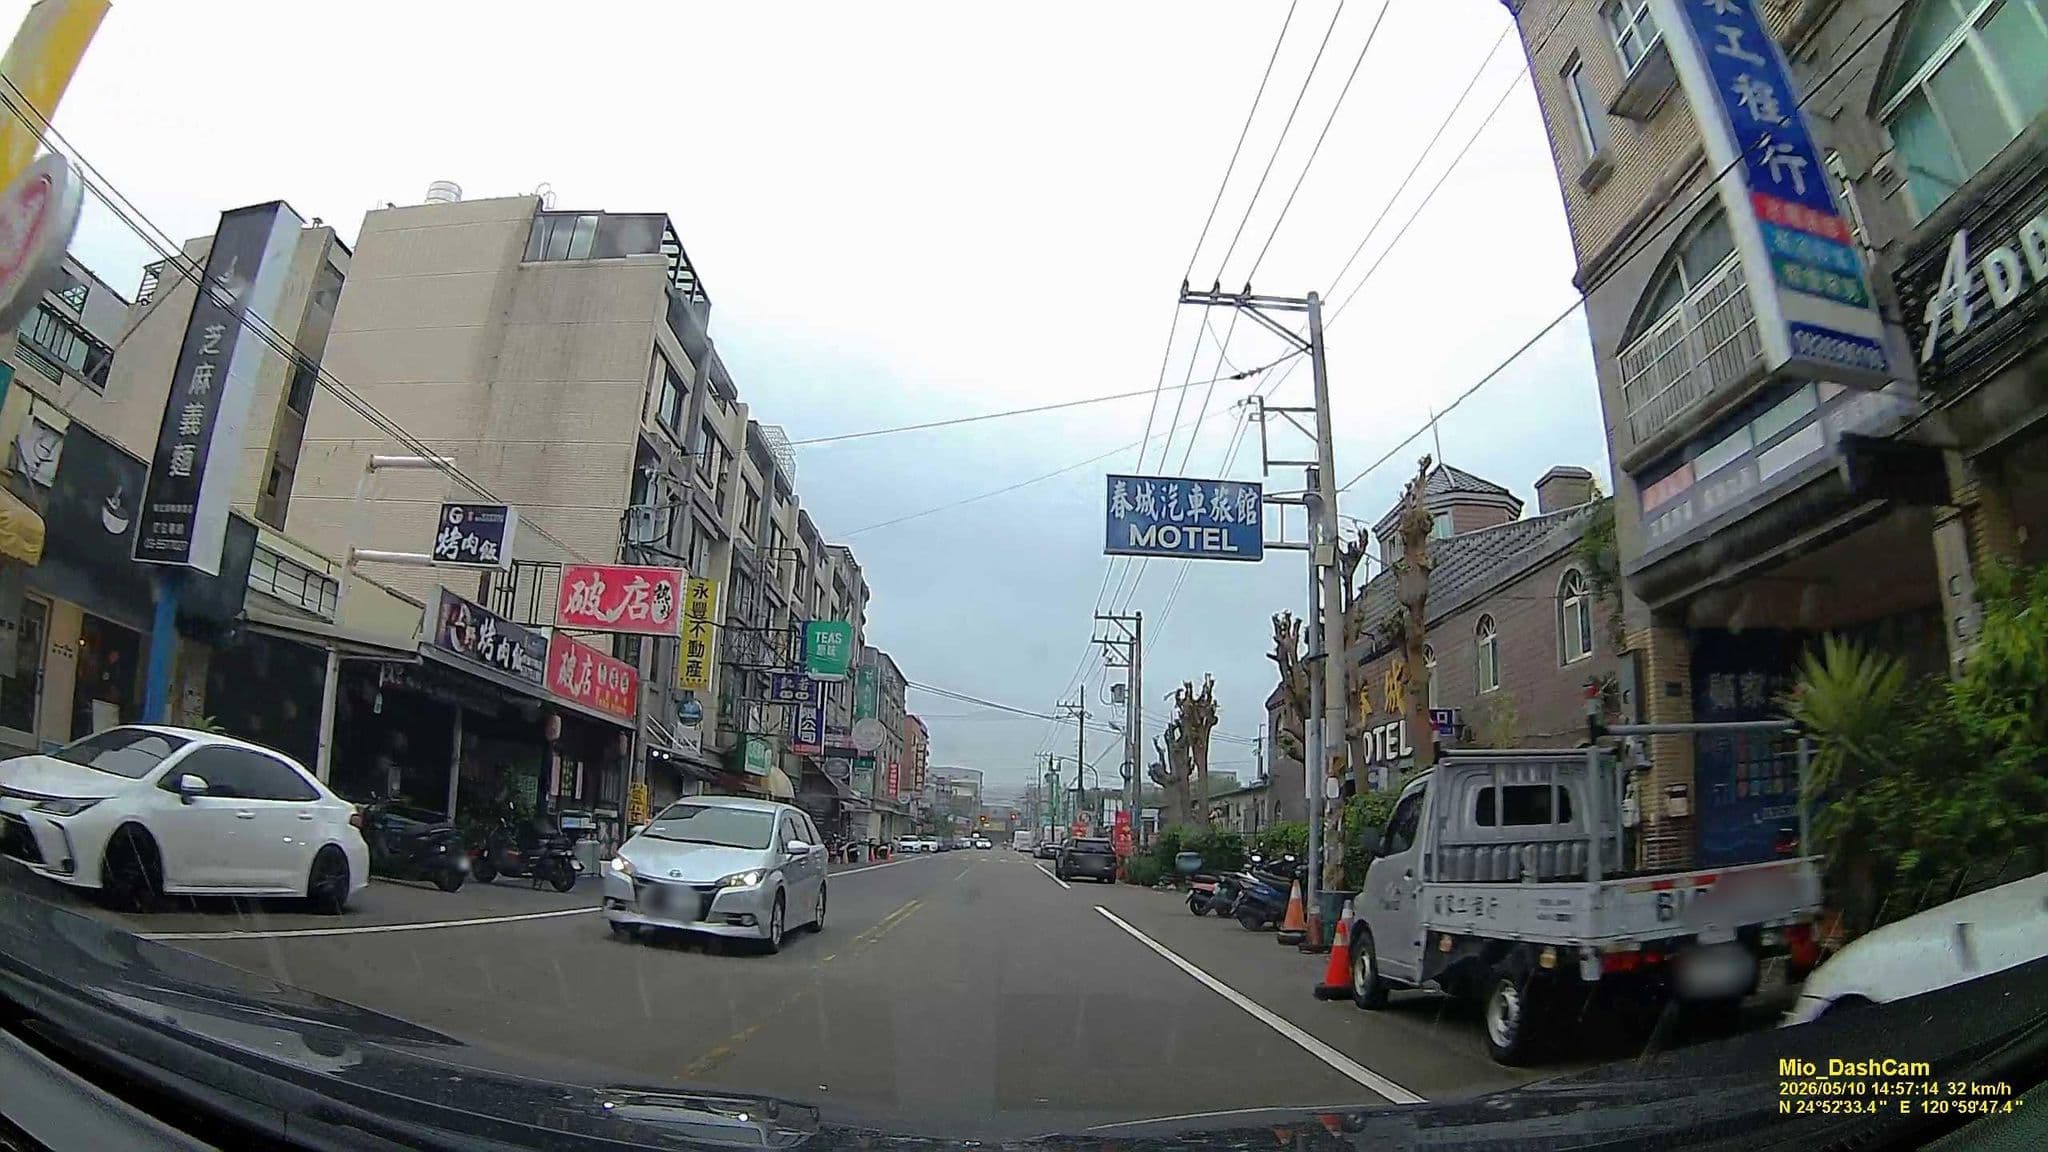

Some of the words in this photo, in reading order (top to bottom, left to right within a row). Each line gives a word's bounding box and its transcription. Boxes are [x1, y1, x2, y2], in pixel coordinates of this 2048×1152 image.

[1110, 479, 1259, 526] 春城汽車旅館
[435, 525, 498, 561] 烤肉飯
[1128, 523, 1239, 552] MOTEL
[477, 616, 524, 673] 烤肉飯
[815, 631, 843, 644] TEAS
